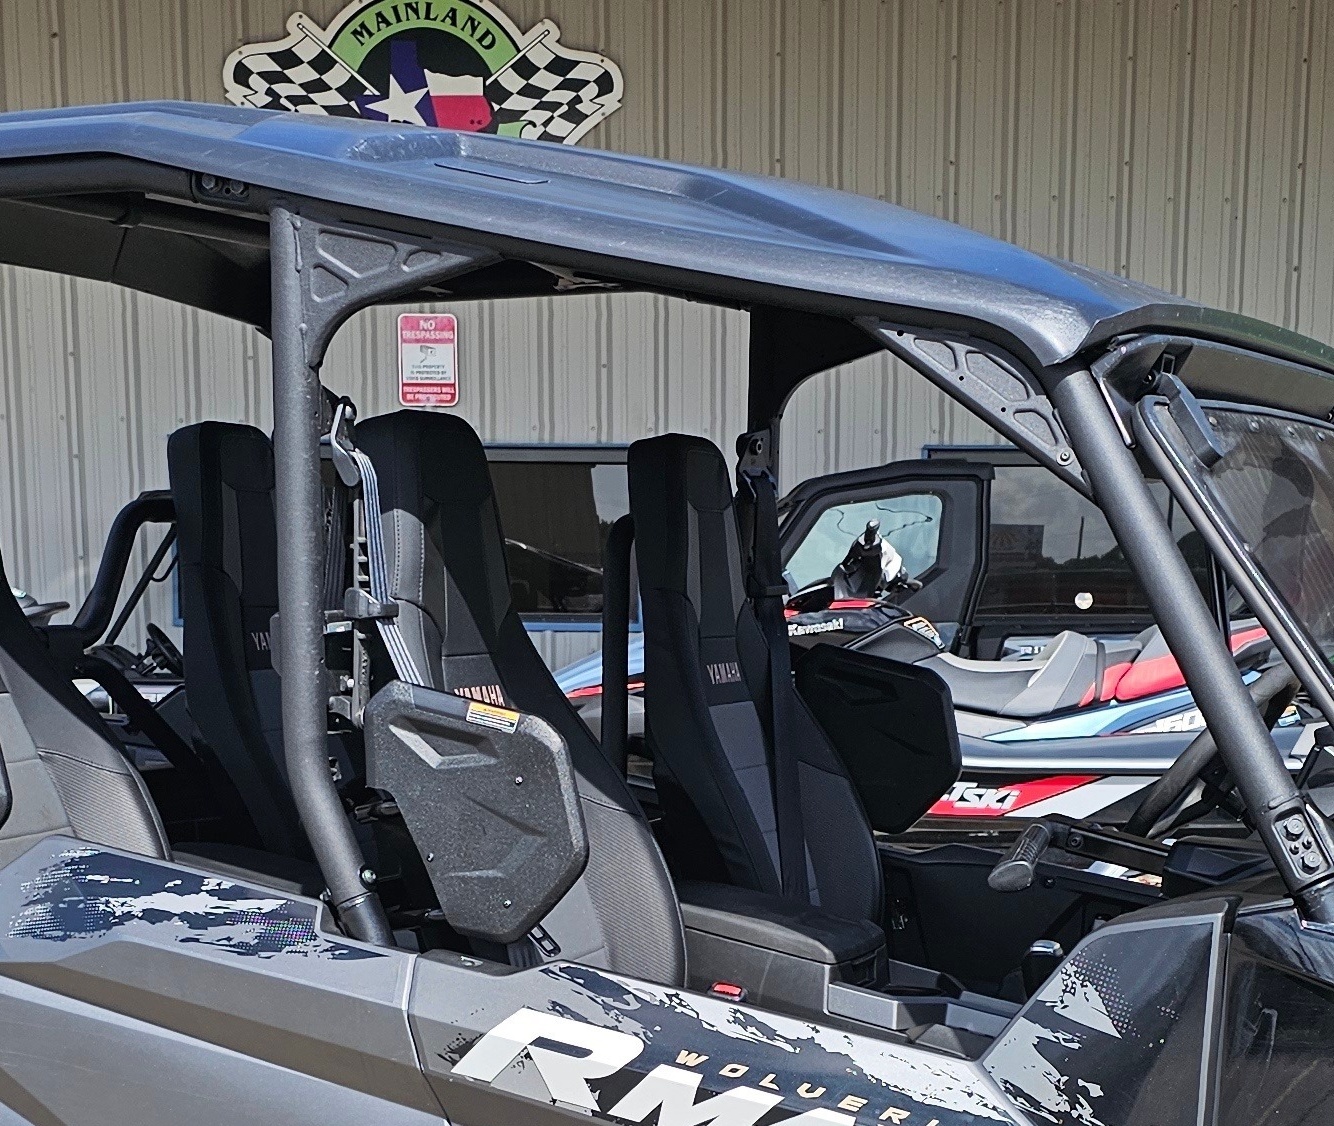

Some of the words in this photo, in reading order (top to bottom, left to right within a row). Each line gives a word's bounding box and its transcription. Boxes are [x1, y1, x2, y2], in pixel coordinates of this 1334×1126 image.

[351, 2, 496, 50] MAINLAND
[419, 320, 435, 330] NO
[402, 330, 453, 339] TRESPASSING
[788, 618, 843, 636] Kawasaki
[706, 662, 741, 684] YAMAHA
